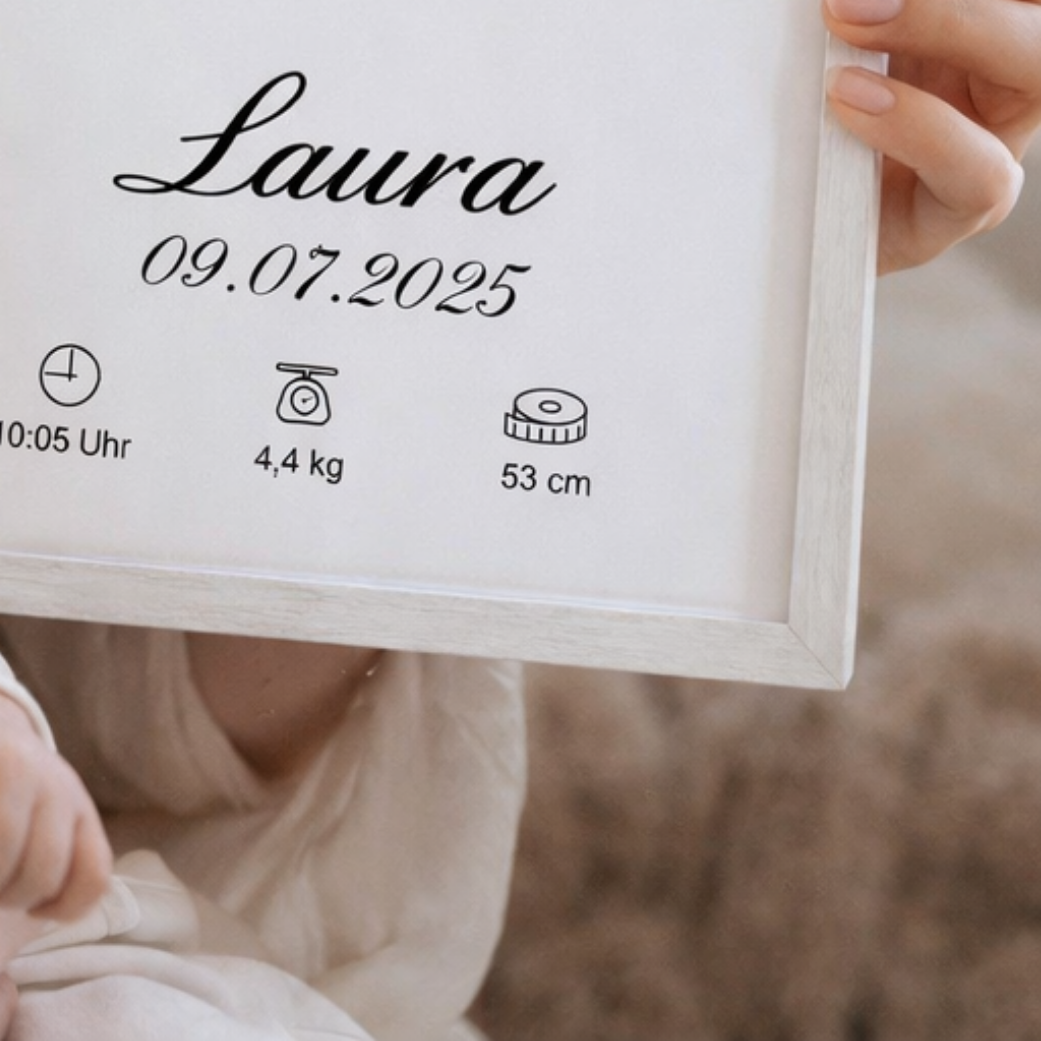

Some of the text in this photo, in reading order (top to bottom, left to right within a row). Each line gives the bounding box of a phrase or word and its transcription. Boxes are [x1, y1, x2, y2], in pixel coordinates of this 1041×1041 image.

[112, 70, 557, 216] Laura
[141, 234, 532, 318] 09.07.2025
[79, 428, 132, 459] Uhr
[253, 445, 344, 485] 4,4 kg
[501, 462, 591, 497] 53 cm
